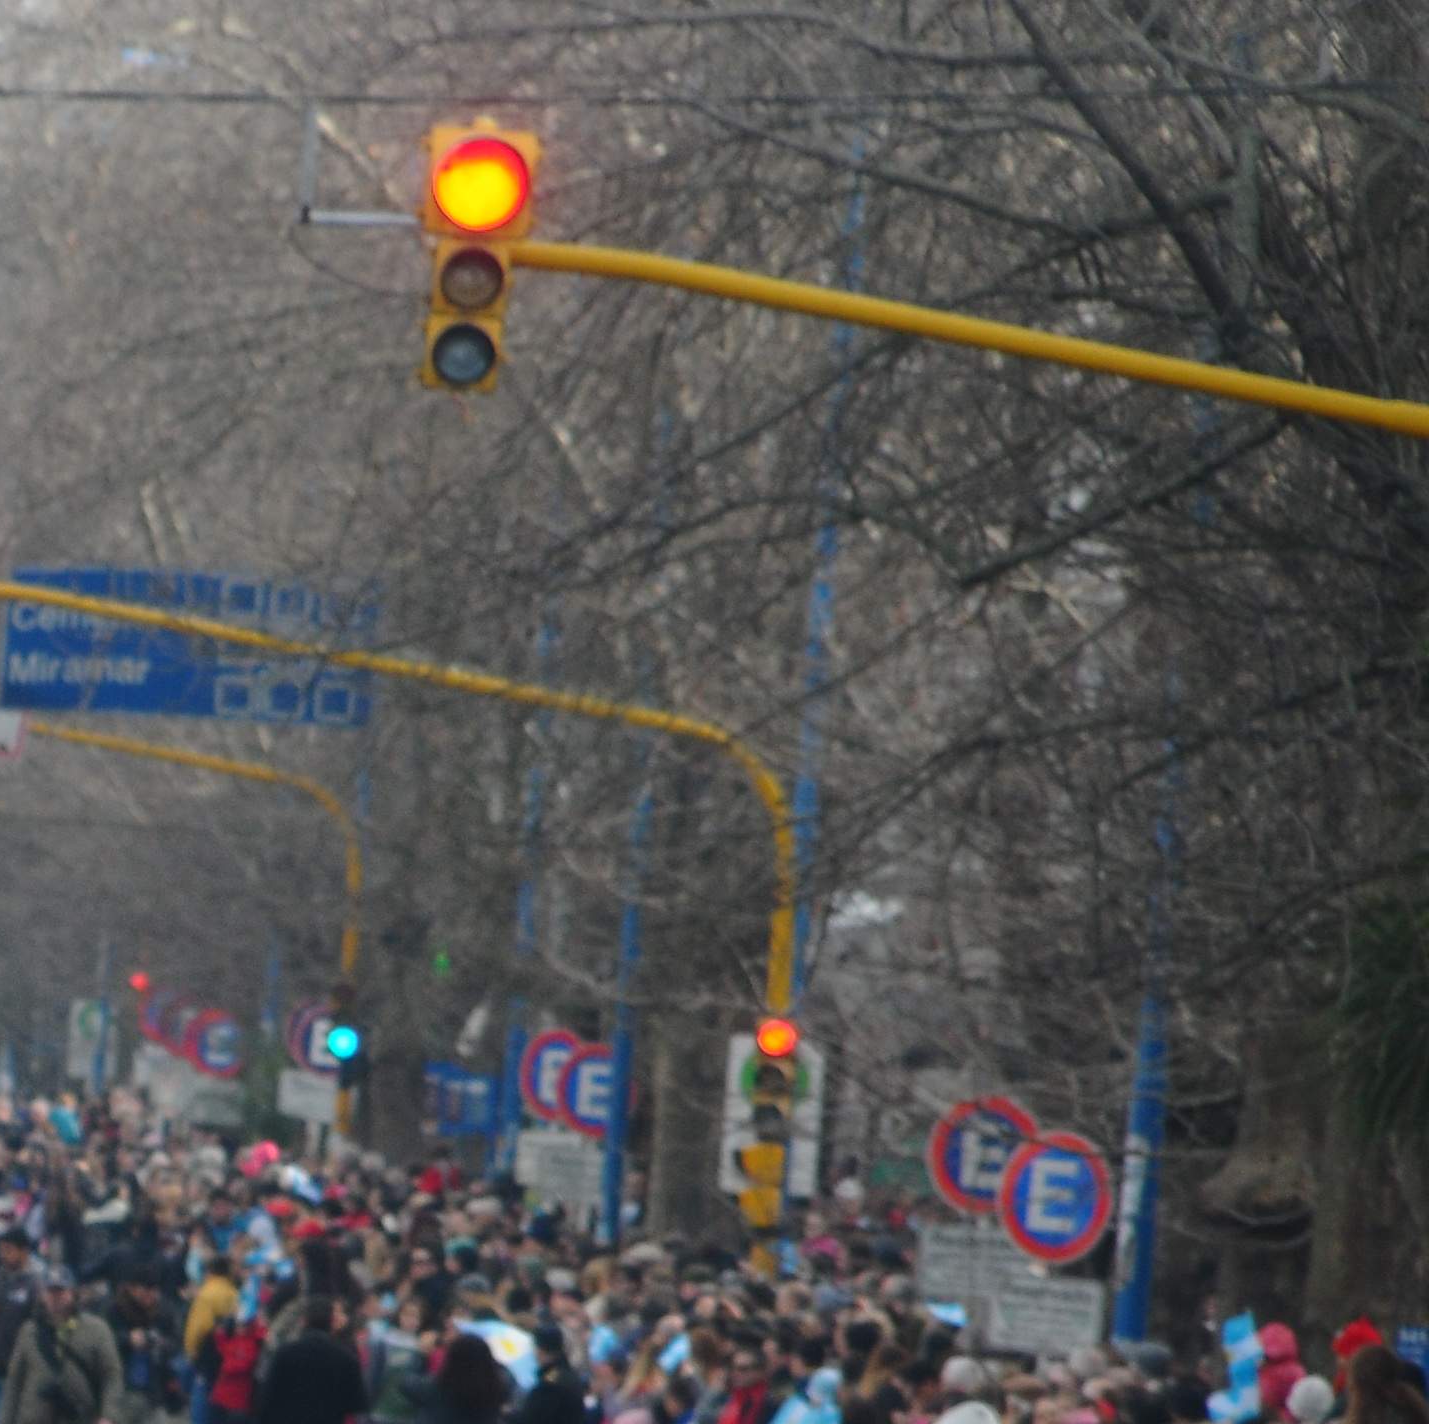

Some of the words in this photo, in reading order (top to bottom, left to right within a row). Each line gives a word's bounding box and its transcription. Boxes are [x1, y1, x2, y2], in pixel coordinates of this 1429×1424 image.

[9, 652, 149, 683] Miramar
[576, 1063, 613, 1119] E
[1027, 1159, 1078, 1233] E
